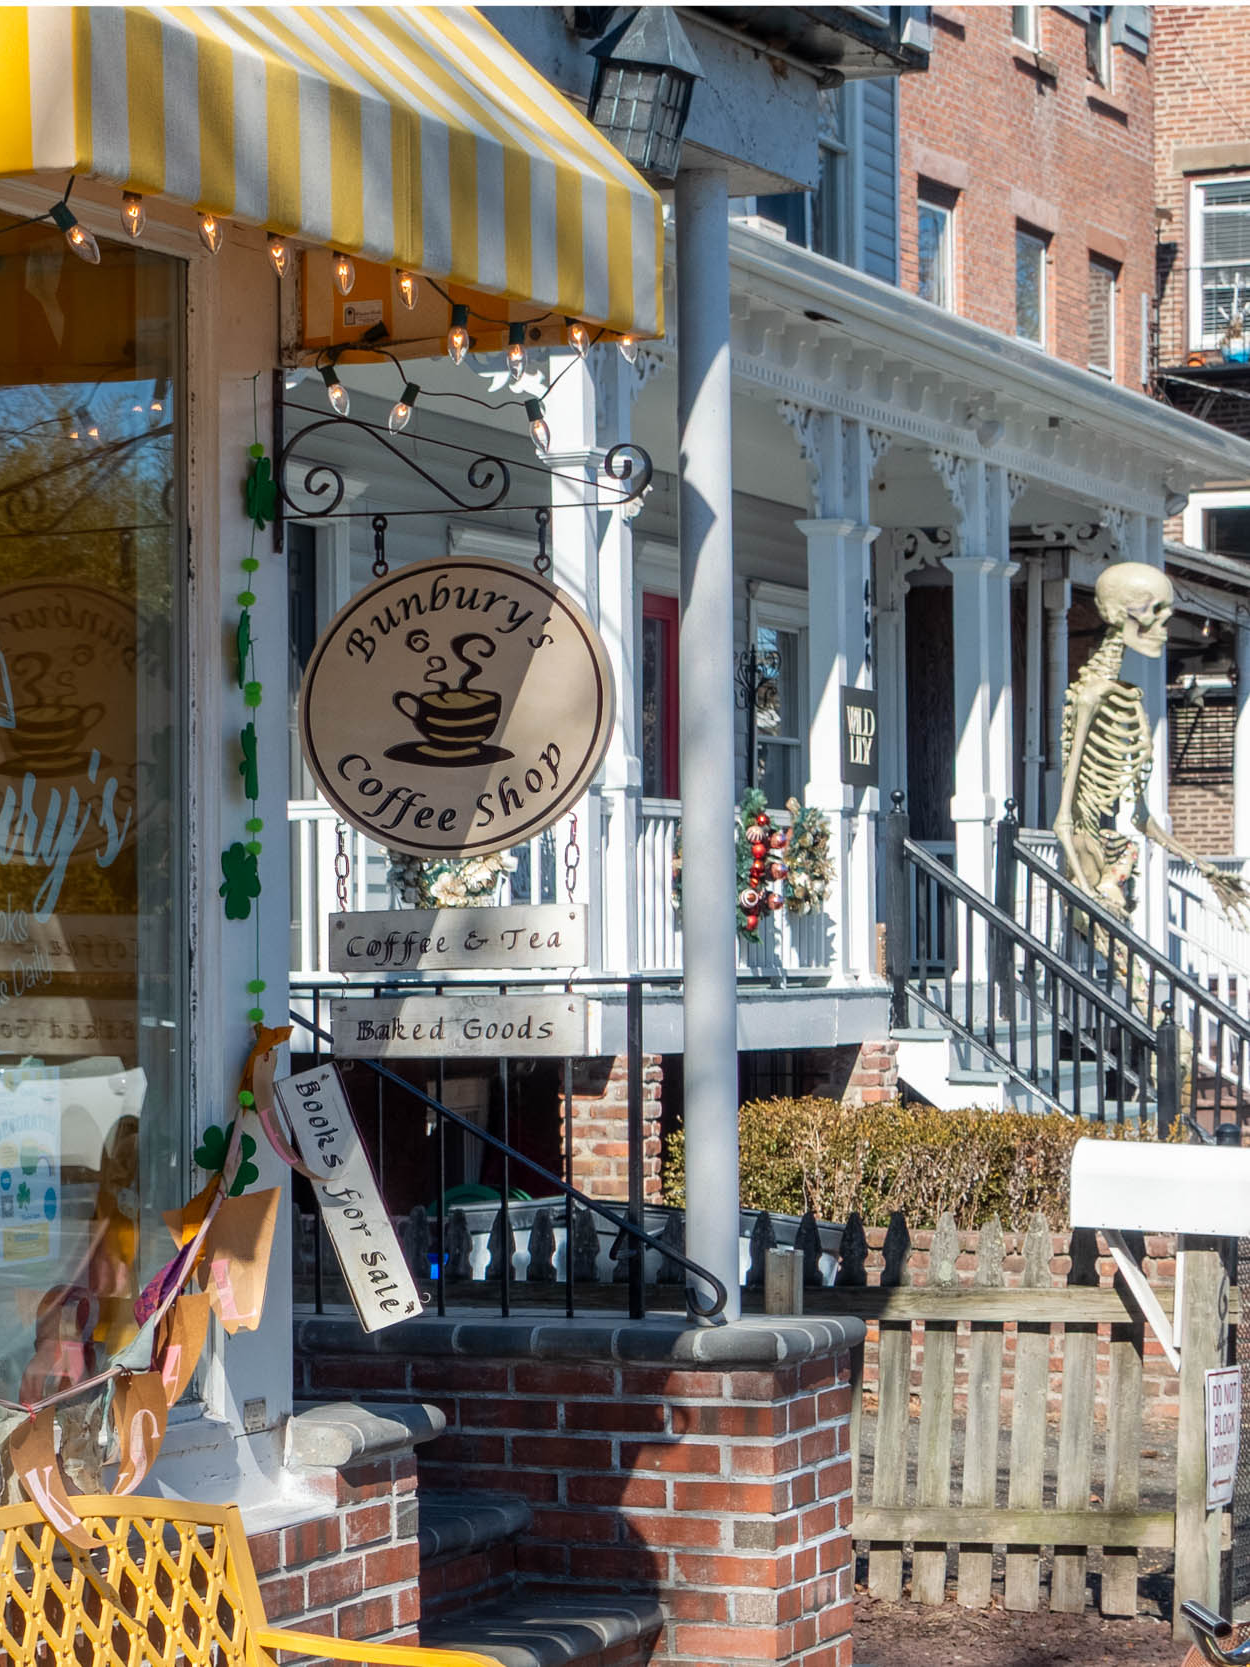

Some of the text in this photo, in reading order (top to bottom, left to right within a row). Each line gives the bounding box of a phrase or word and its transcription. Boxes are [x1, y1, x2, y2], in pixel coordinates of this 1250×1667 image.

[345, 574, 554, 664] Bunbury's
[846, 705, 876, 737] WILD
[337, 742, 562, 831] Coffee Shop
[11, 944, 54, 998] Daily
[346, 927, 563, 965] Coffee & Tea
[356, 1014, 554, 1041] Baked Goods
[295, 1079, 344, 1169] Books
[322, 1184, 372, 1238] for
[361, 1250, 400, 1314] sale
[1214, 1413, 1236, 1437] BLOCK
